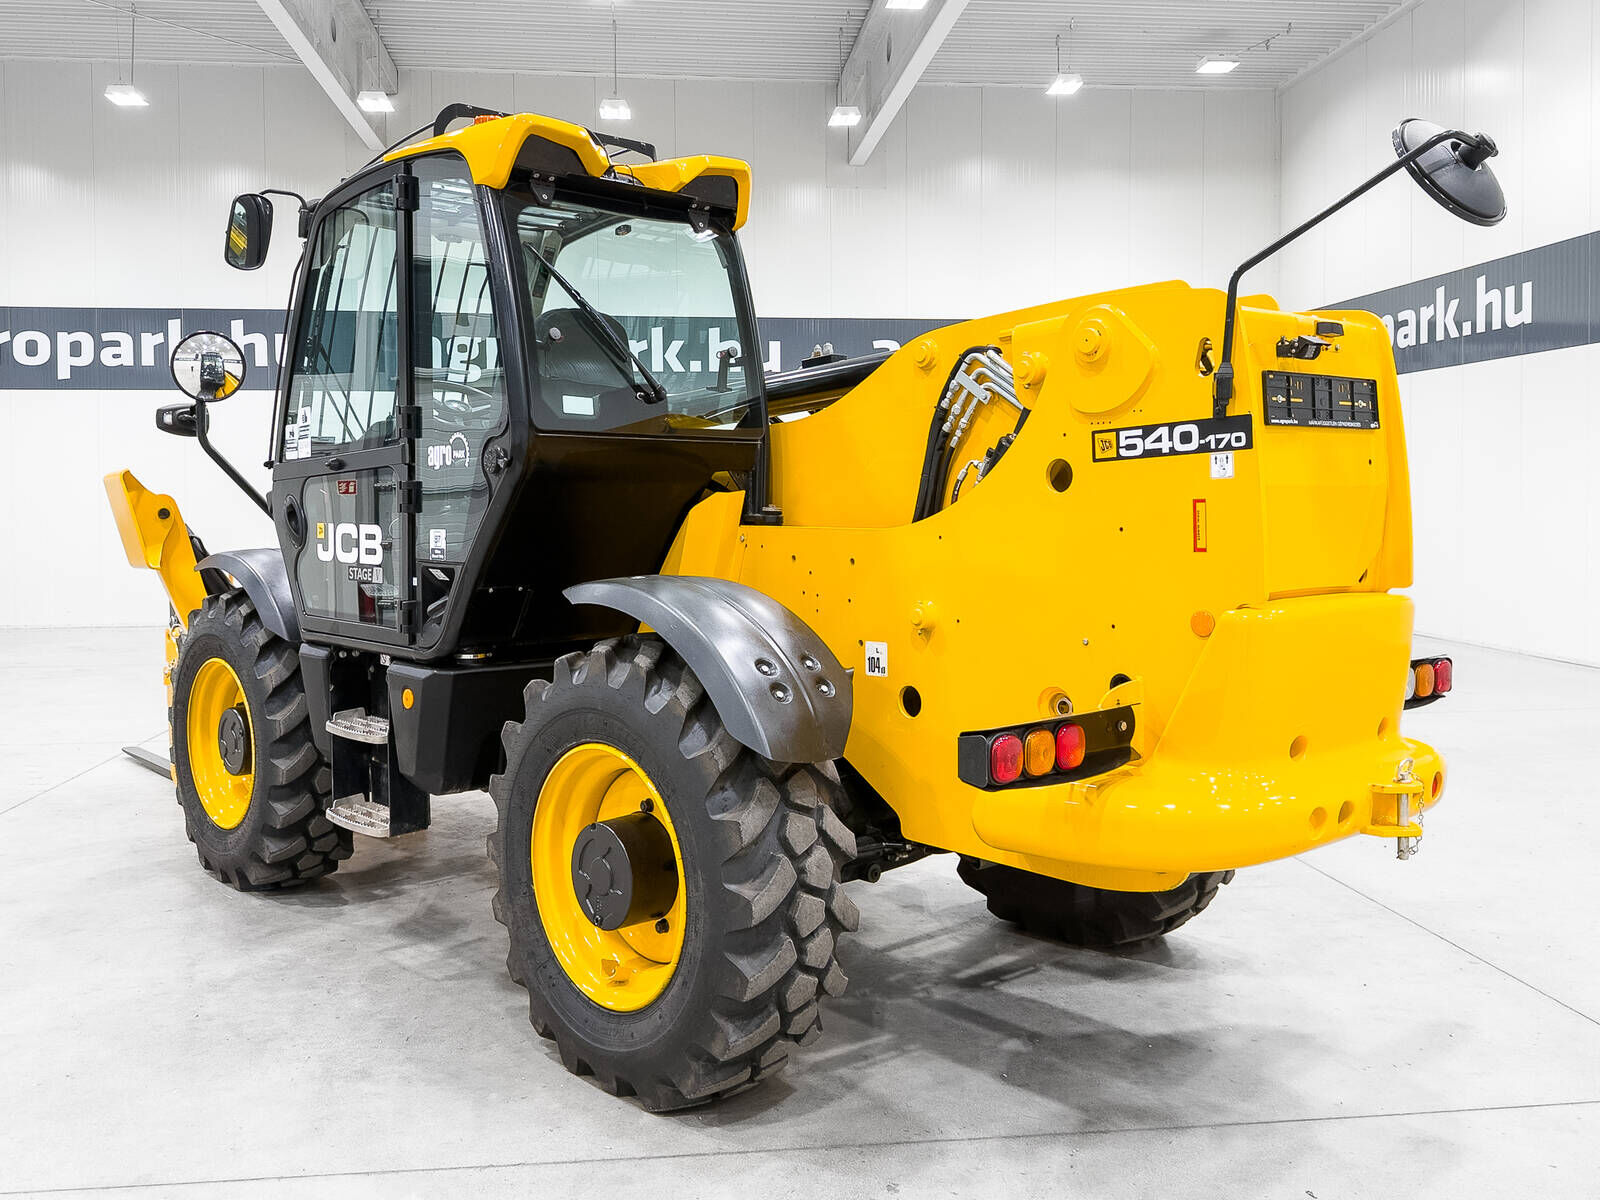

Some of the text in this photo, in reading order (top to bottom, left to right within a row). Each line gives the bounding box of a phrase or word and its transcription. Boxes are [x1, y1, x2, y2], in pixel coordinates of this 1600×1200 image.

[427, 445, 452, 470] agro
[316, 522, 383, 566] JCB
[348, 566, 373, 581] STAGE
[867, 656, 881, 673] 104
